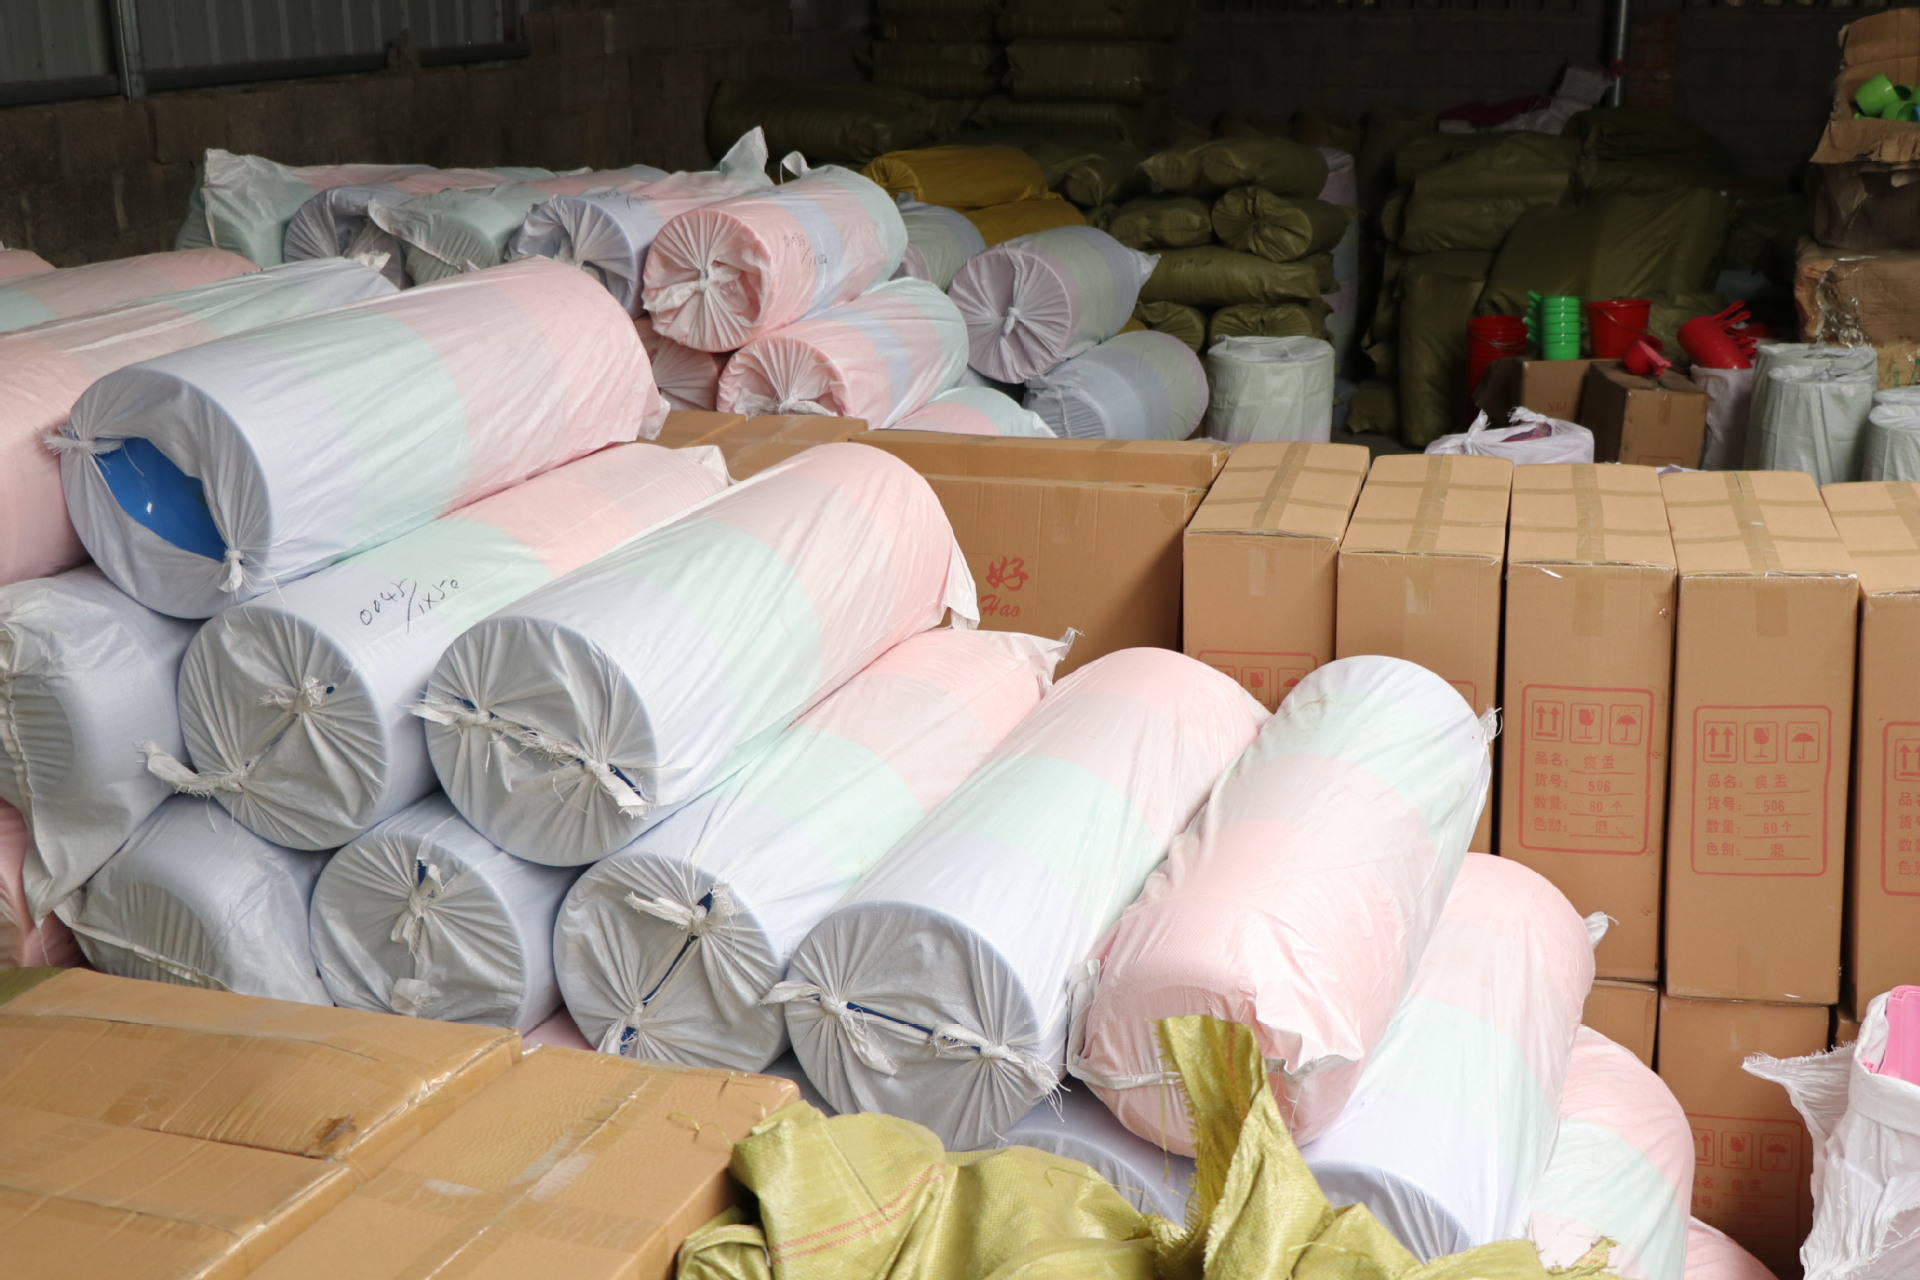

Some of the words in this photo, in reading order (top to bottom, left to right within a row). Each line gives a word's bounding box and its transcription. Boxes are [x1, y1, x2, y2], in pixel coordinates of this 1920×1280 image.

[985, 556, 1029, 592] 好
[980, 594, 1022, 618] Hao
[1535, 751, 1568, 767] 品名：
[1534, 773, 1568, 788] 货号：
[1588, 780, 1611, 792] 506
[1707, 773, 1742, 789] 品名：
[1707, 796, 1742, 811] 货号：
[1763, 800, 1785, 812] 506
